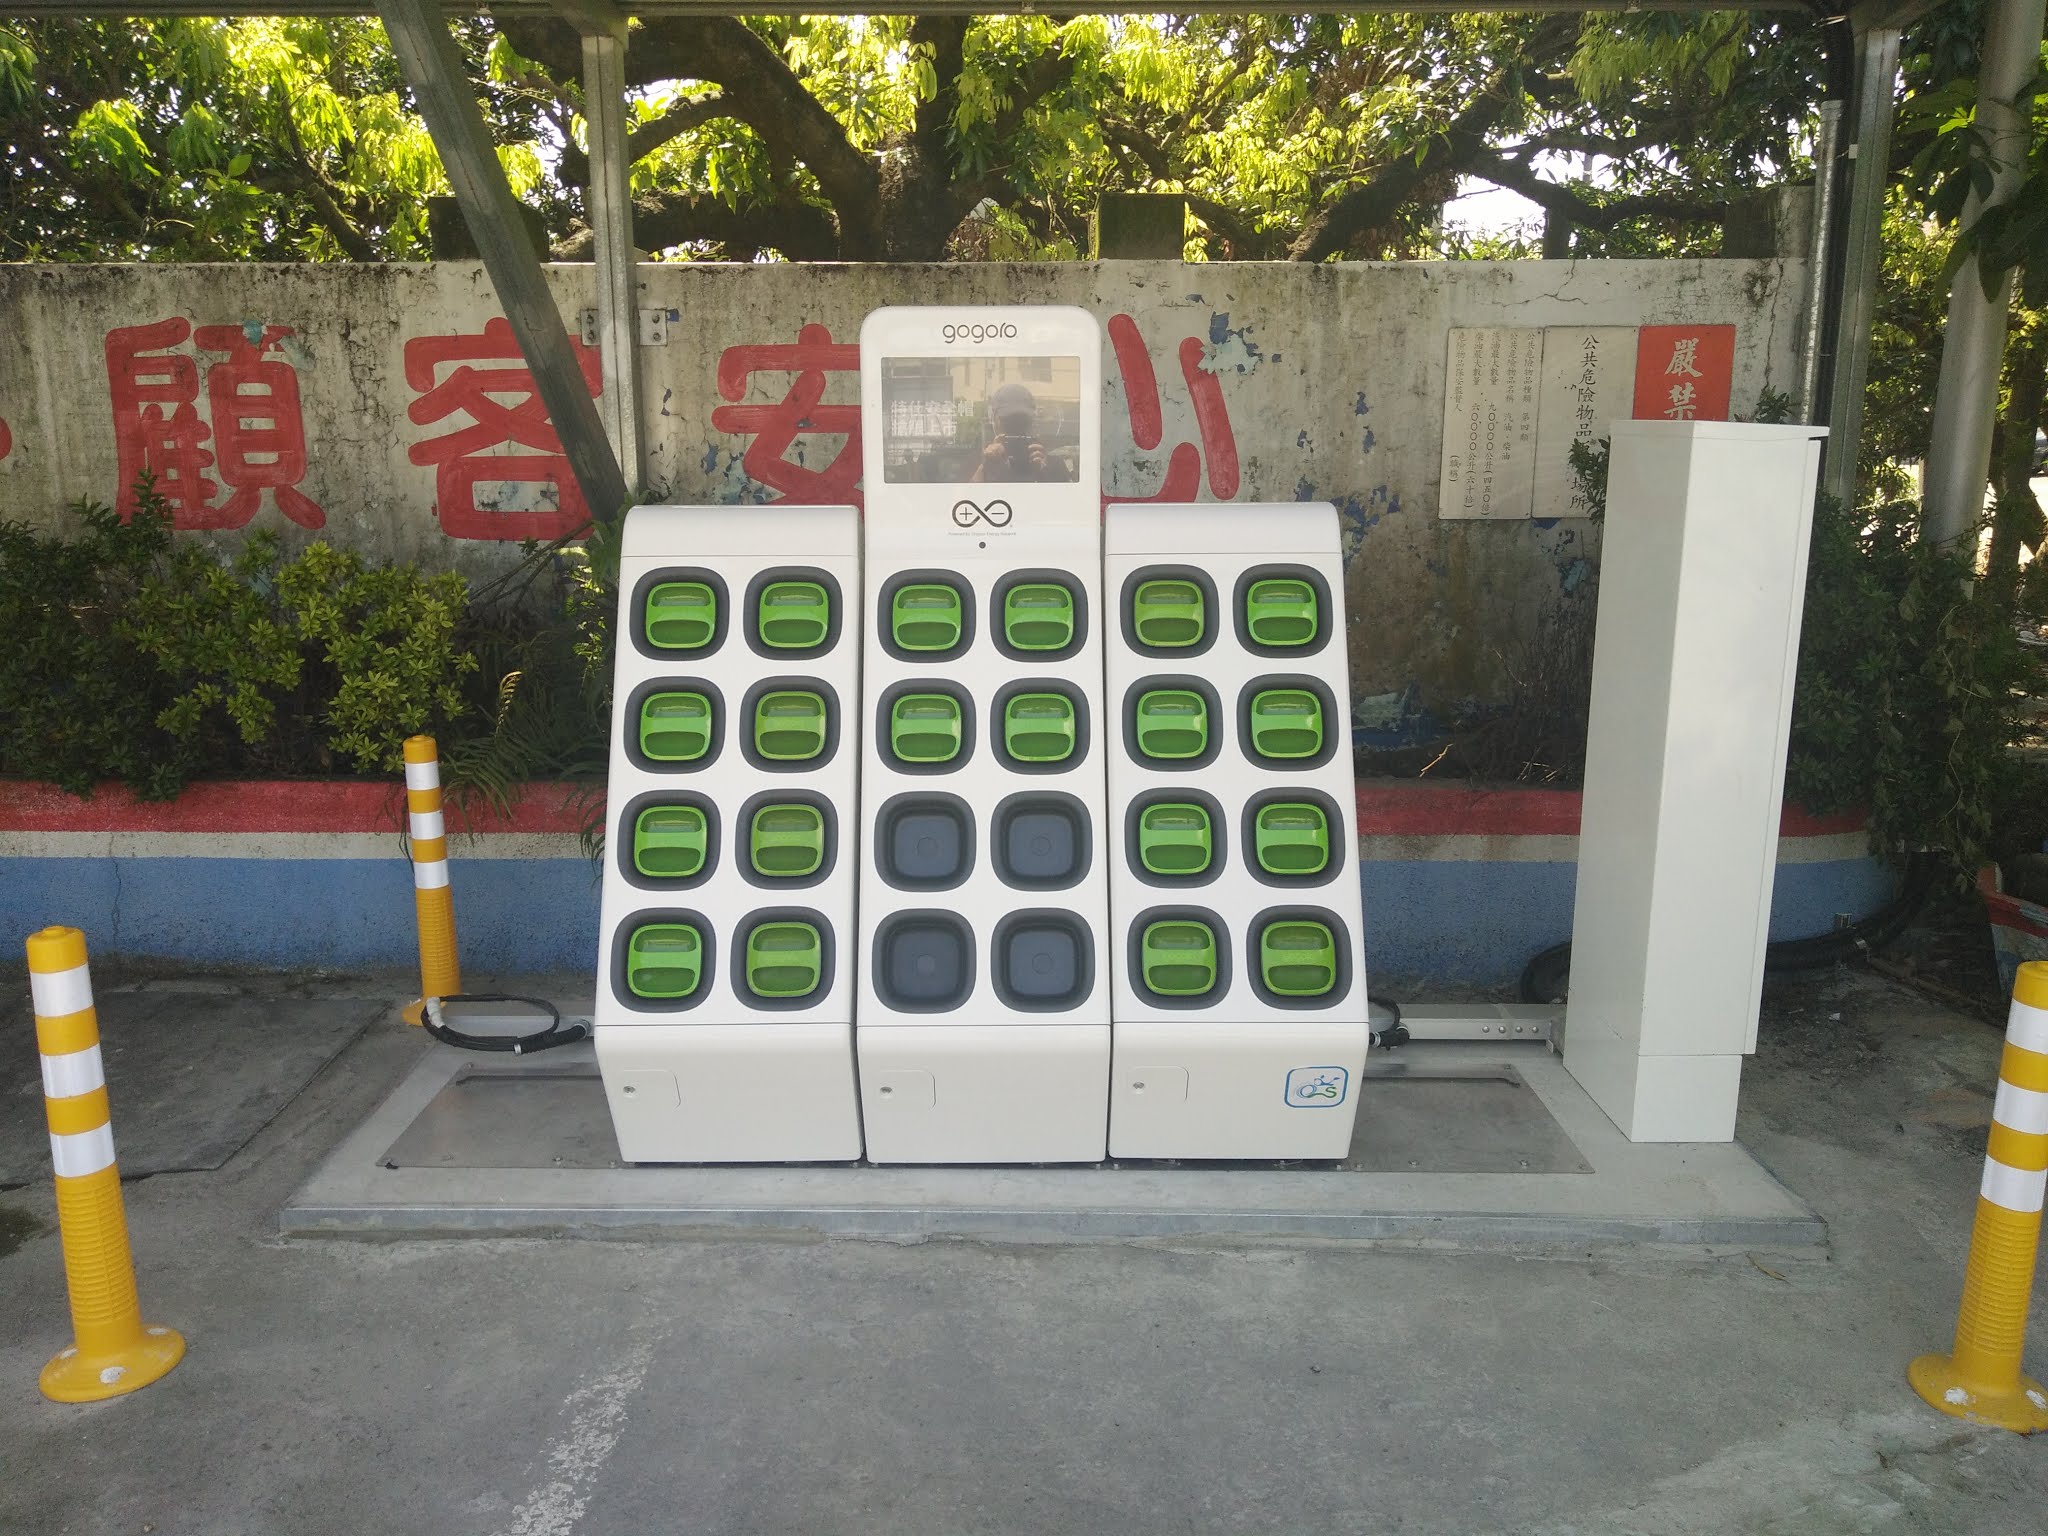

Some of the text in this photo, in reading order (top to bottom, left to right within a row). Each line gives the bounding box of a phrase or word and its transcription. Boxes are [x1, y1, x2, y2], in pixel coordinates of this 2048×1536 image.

[942, 322, 1017, 344] gogoro
[1664, 337, 1704, 421] 嚴禁
[1569, 334, 1600, 510] 公共危險物品場所
